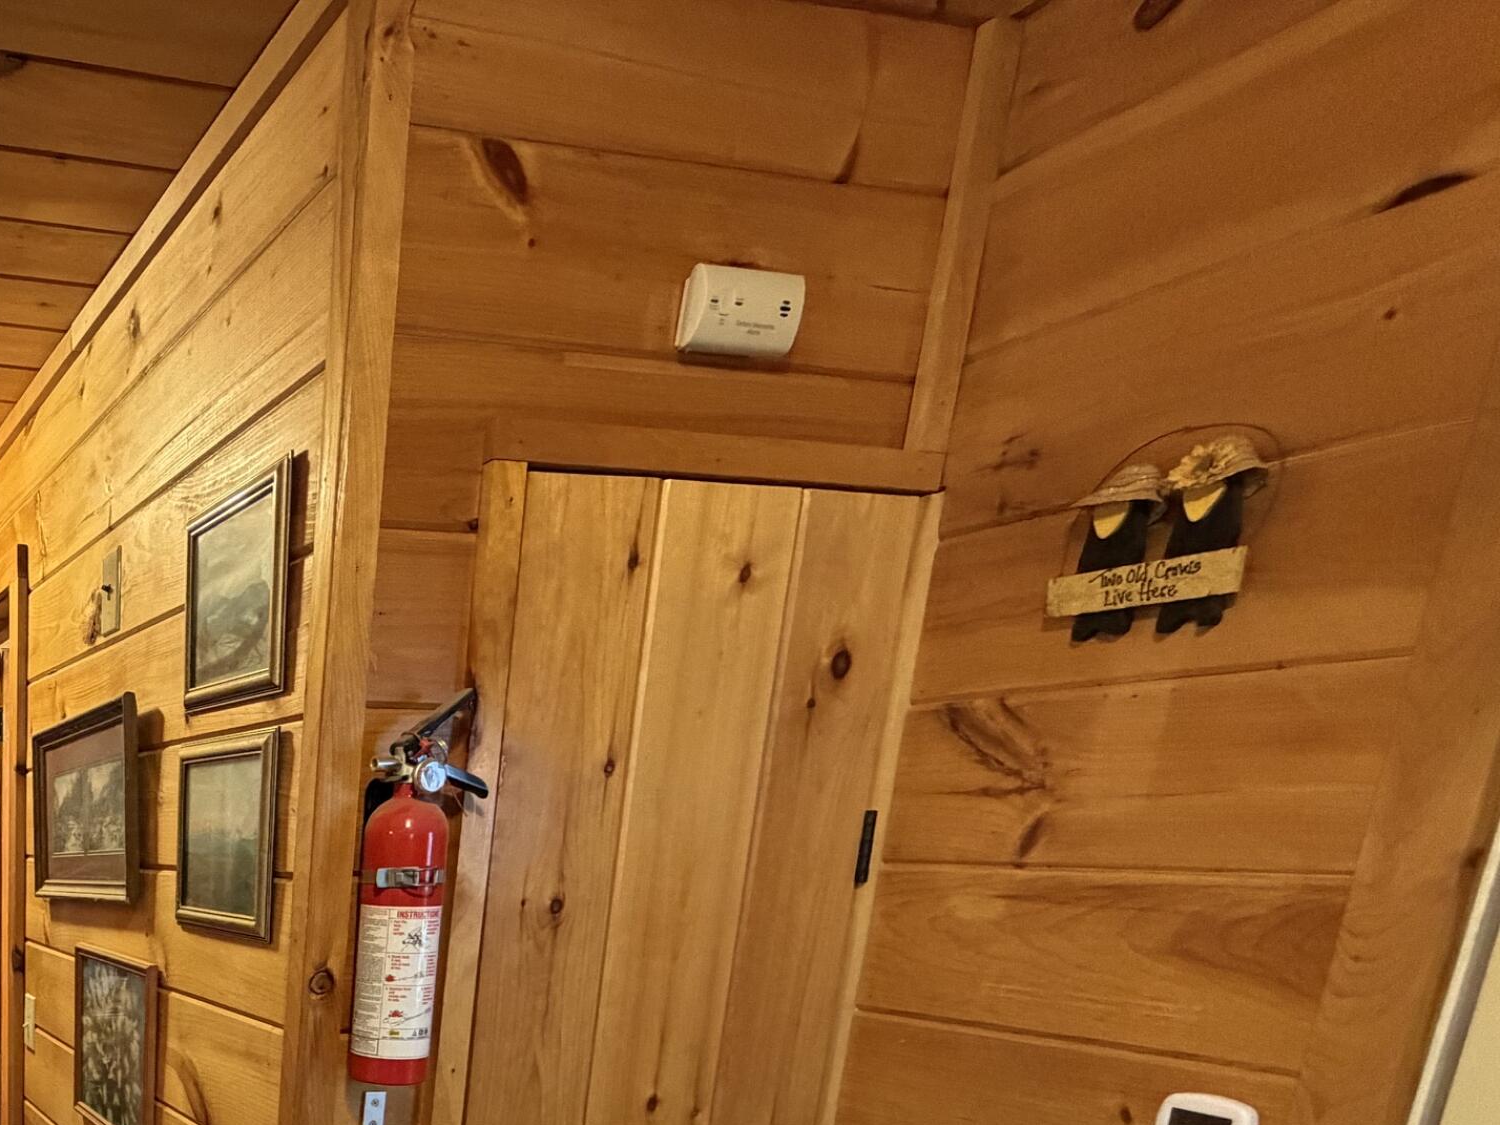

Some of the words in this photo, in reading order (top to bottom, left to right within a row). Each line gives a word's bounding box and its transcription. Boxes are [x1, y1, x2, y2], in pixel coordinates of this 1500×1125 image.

[1088, 568, 1123, 588] Two
[1126, 562, 1150, 584] Old
[1155, 561, 1201, 580] Crows
[1103, 589, 1133, 607] Live
[1137, 578, 1178, 602] Here
